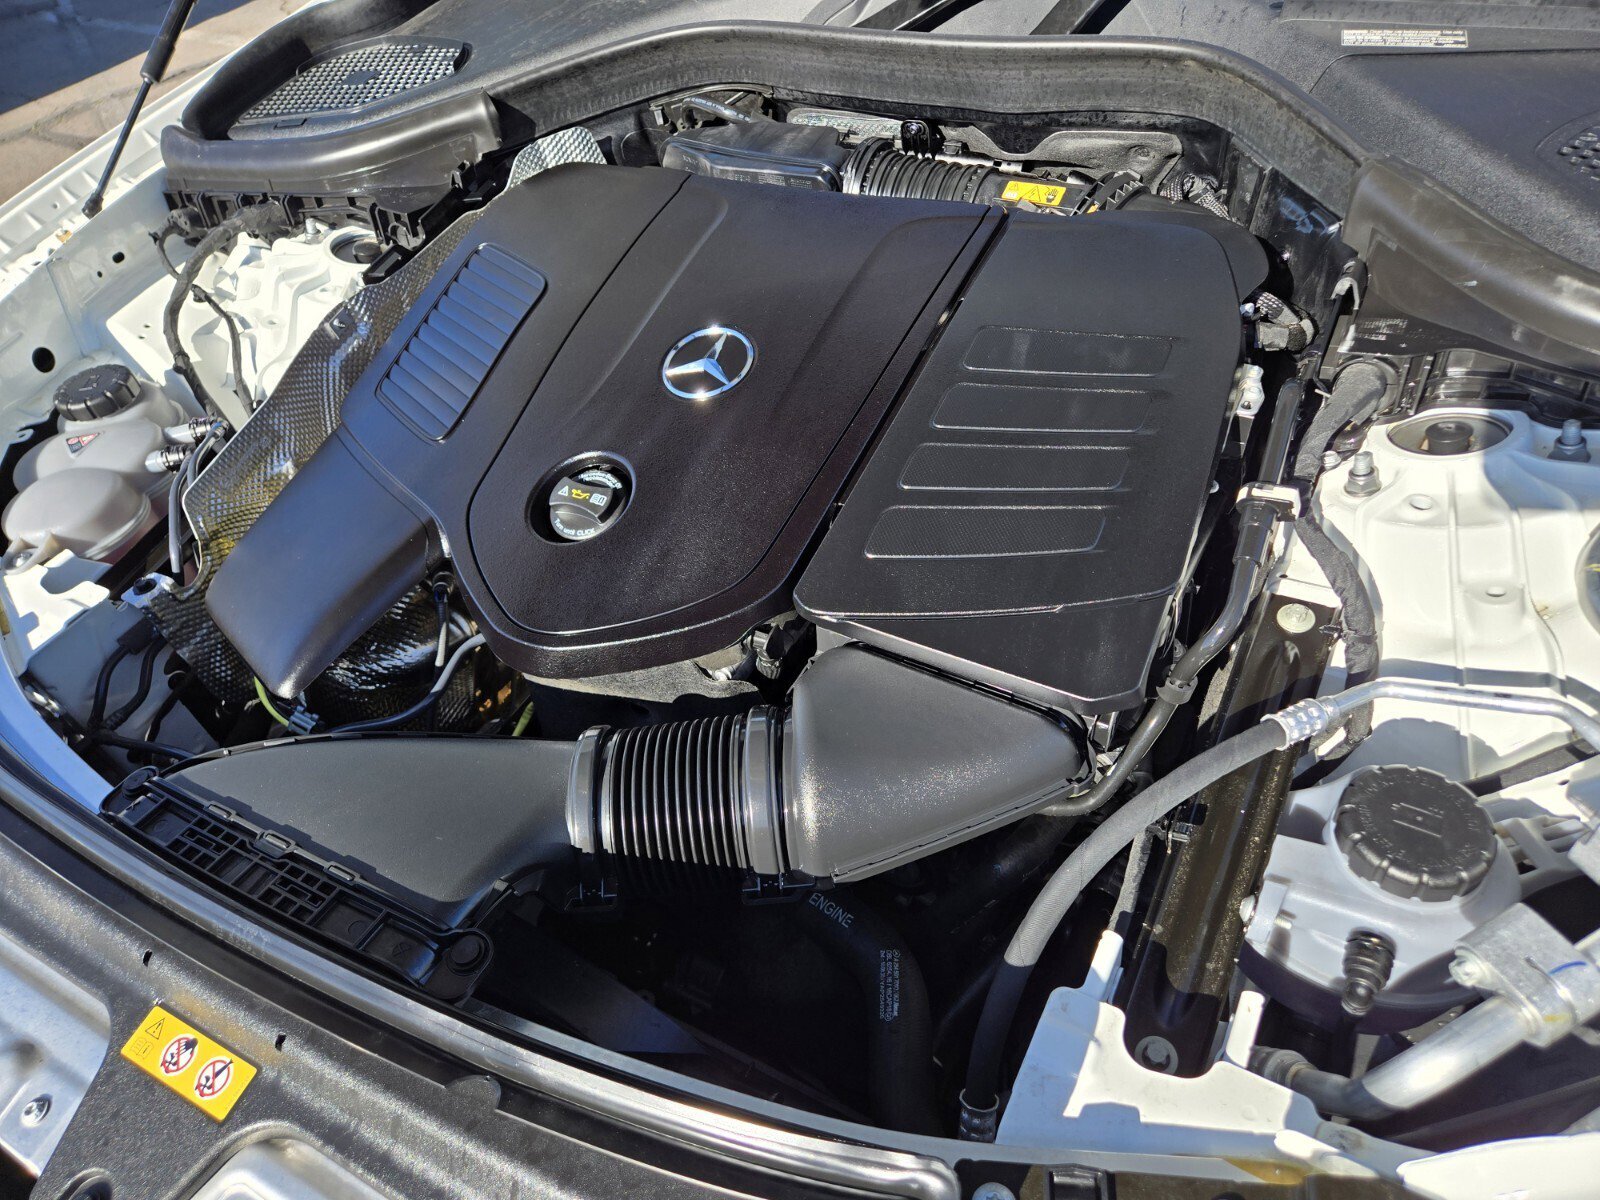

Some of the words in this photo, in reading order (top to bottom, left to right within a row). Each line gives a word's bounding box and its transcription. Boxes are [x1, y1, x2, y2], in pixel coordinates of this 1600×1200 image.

[554, 518, 564, 531] Turn
[563, 528, 576, 536] until
[576, 528, 596, 536] CLICK
[808, 892, 855, 929] ENGINE
